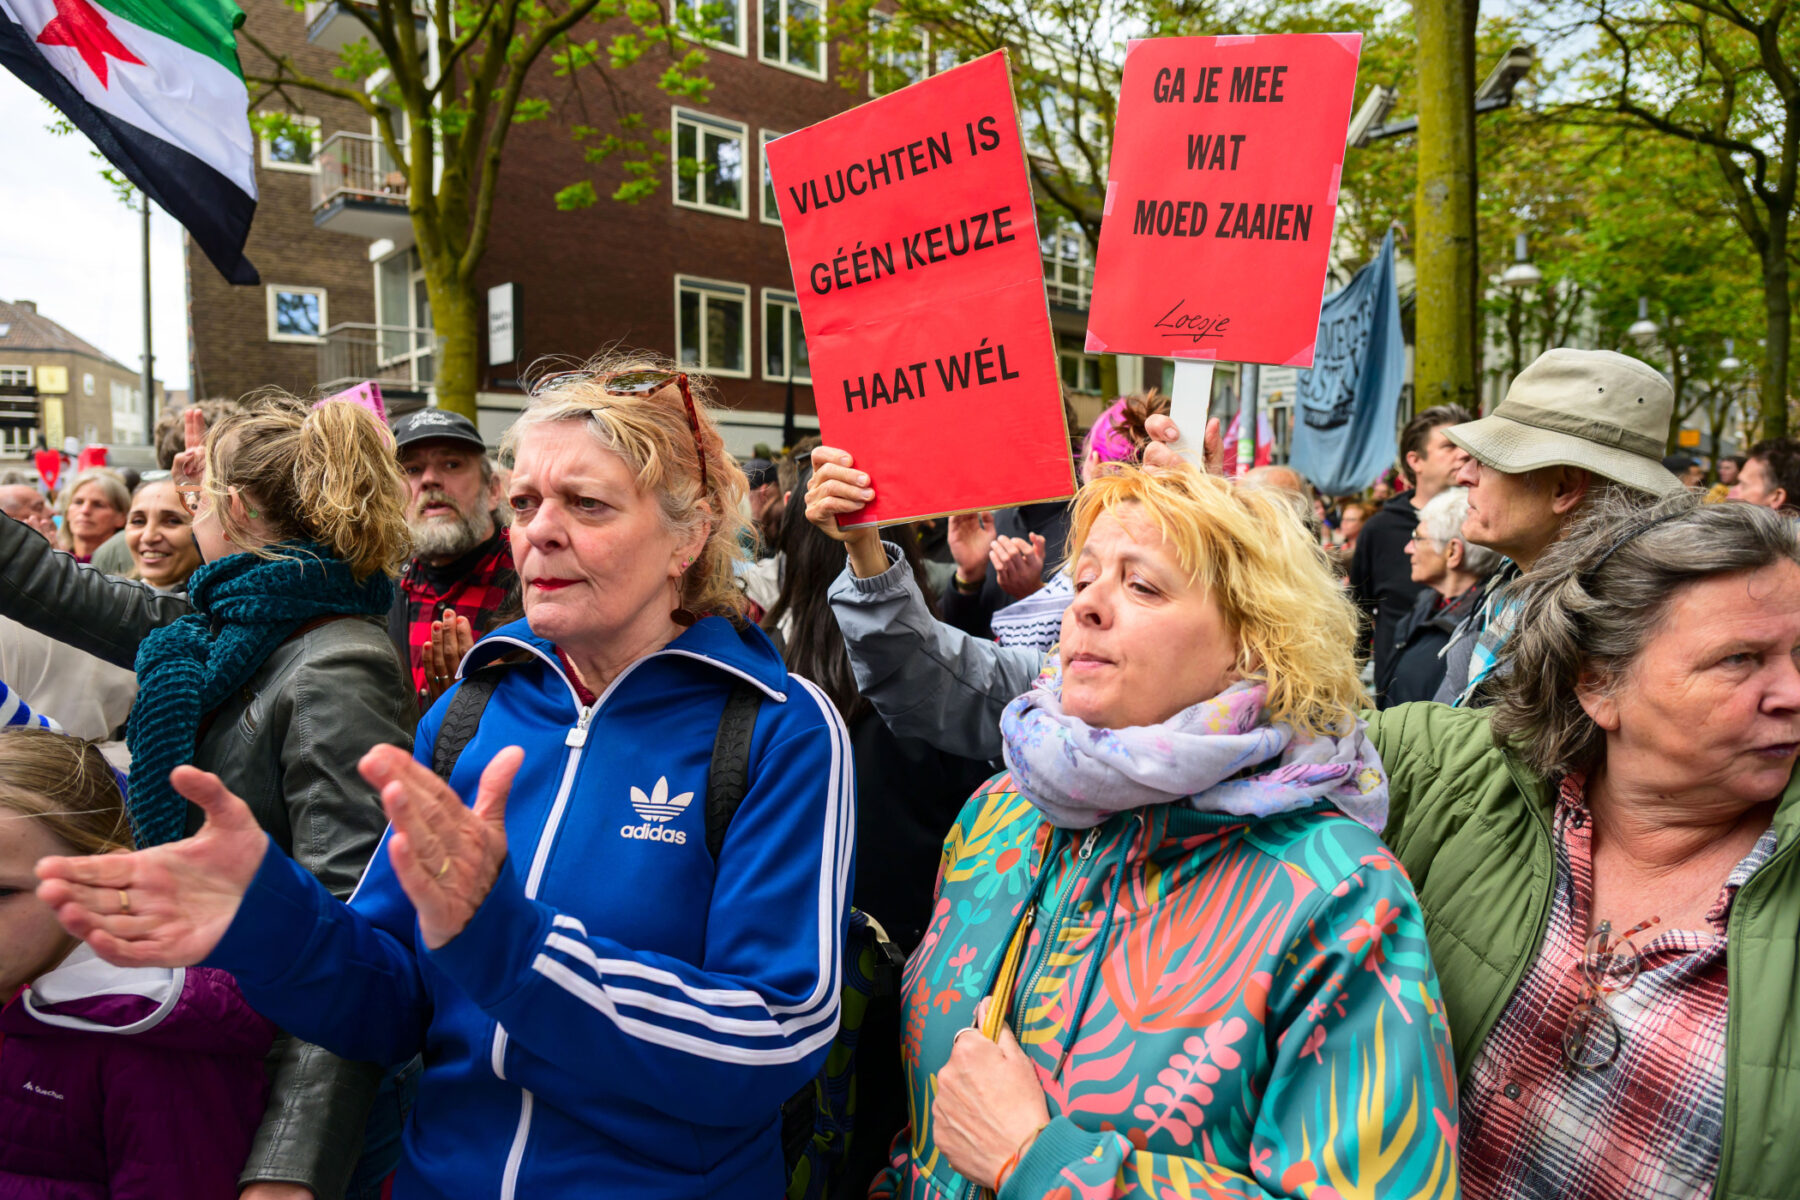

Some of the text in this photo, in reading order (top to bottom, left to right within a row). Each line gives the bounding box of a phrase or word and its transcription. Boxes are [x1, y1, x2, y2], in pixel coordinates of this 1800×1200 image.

[1153, 66, 1288, 103] GA JE MEE
[789, 115, 1000, 215] VLUCHTEN IS
[1187, 134, 1246, 171] WAT
[1133, 199, 1313, 242] MOED ZAAIEN
[810, 205, 1016, 296] GÉÉN KEUZE
[1154, 299, 1231, 343] Loesje
[842, 337, 1019, 413] HAAT WÉL
[620, 823, 687, 845] adidas
